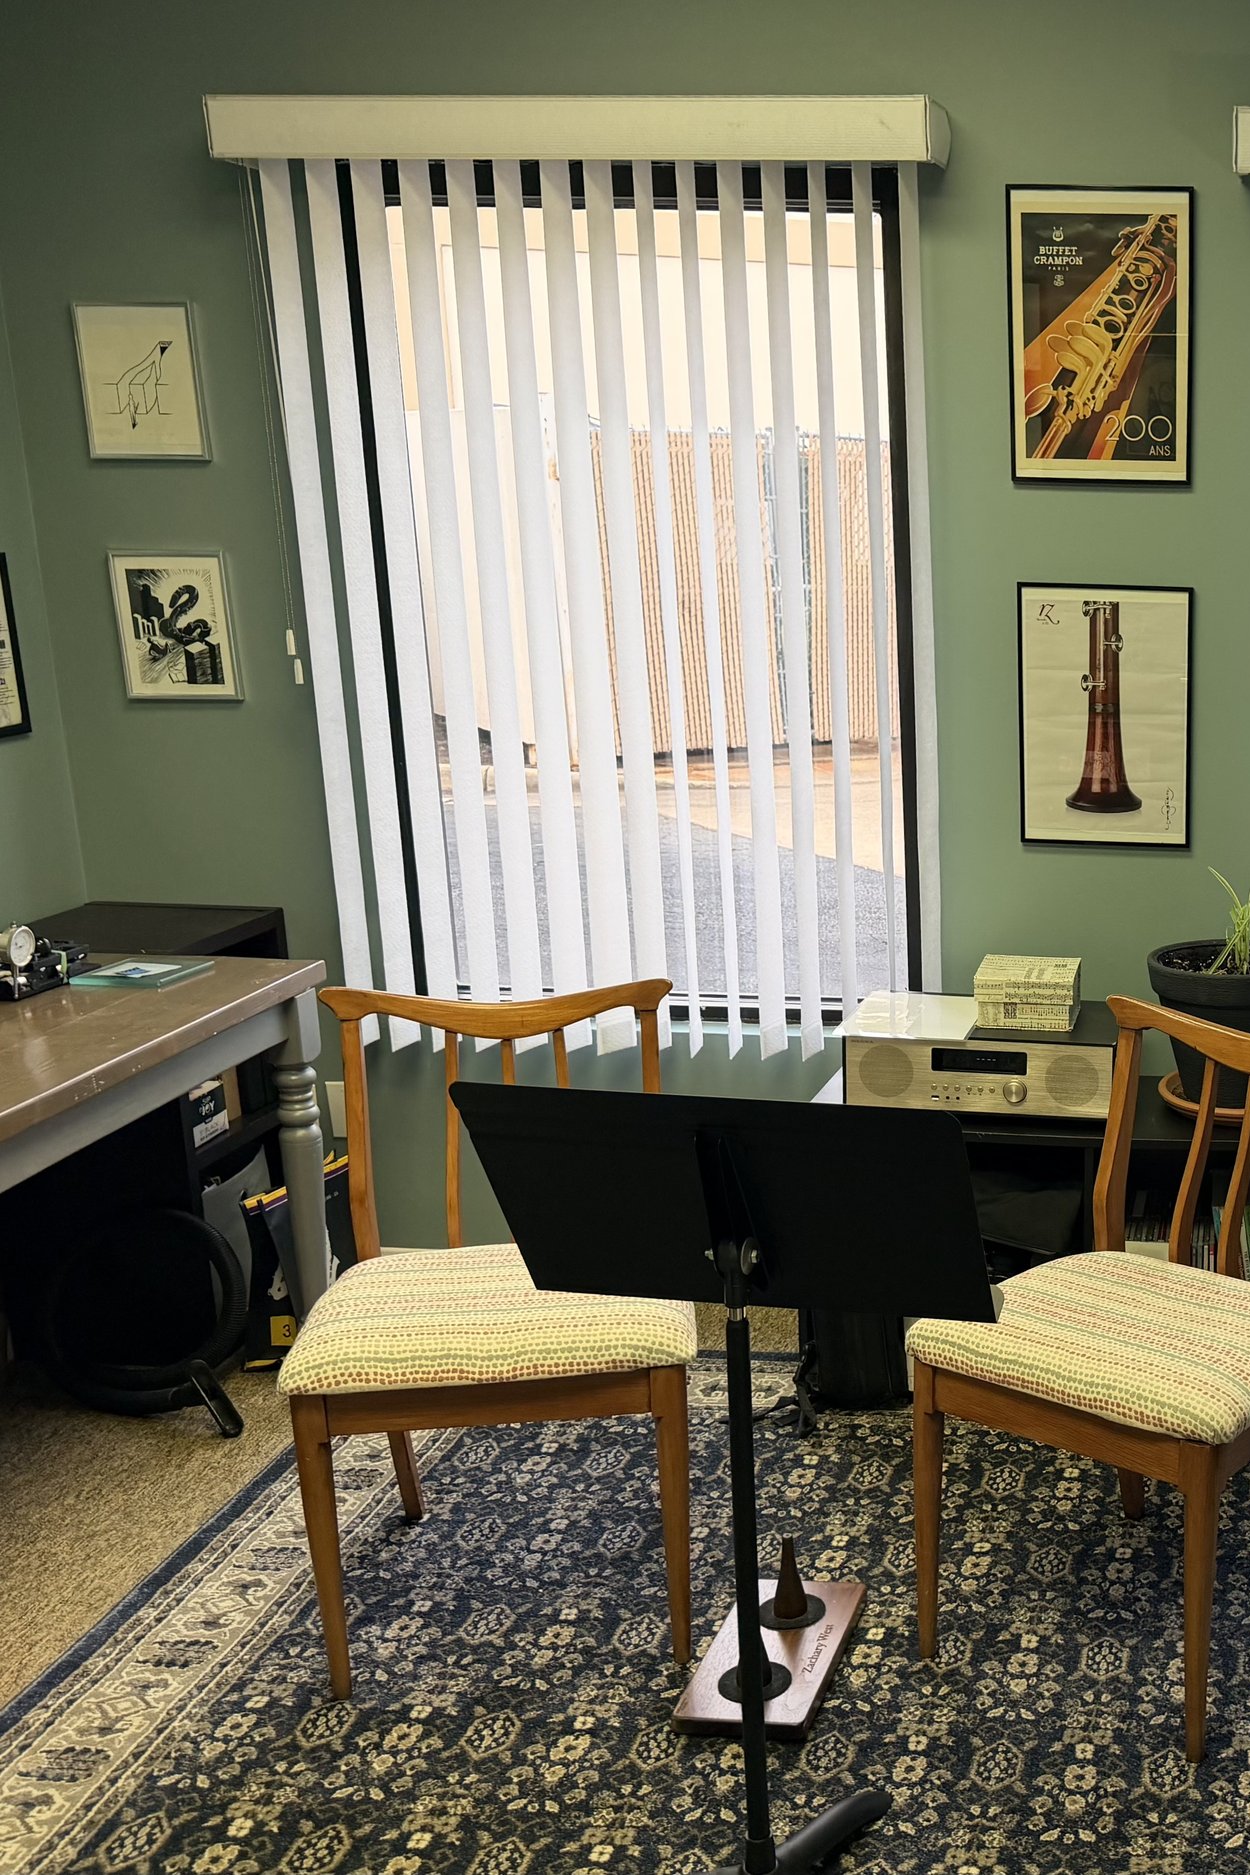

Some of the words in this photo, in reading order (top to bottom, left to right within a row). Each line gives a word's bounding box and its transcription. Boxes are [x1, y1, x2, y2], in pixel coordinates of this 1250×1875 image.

[1039, 246, 1078, 255] BUFFET
[1033, 255, 1084, 265] CRAMPON
[1105, 415, 1173, 442] 200
[1149, 445, 1171, 457] ANS
[282, 1323, 292, 1338] 3
[802, 1642, 828, 1673] Zachary
